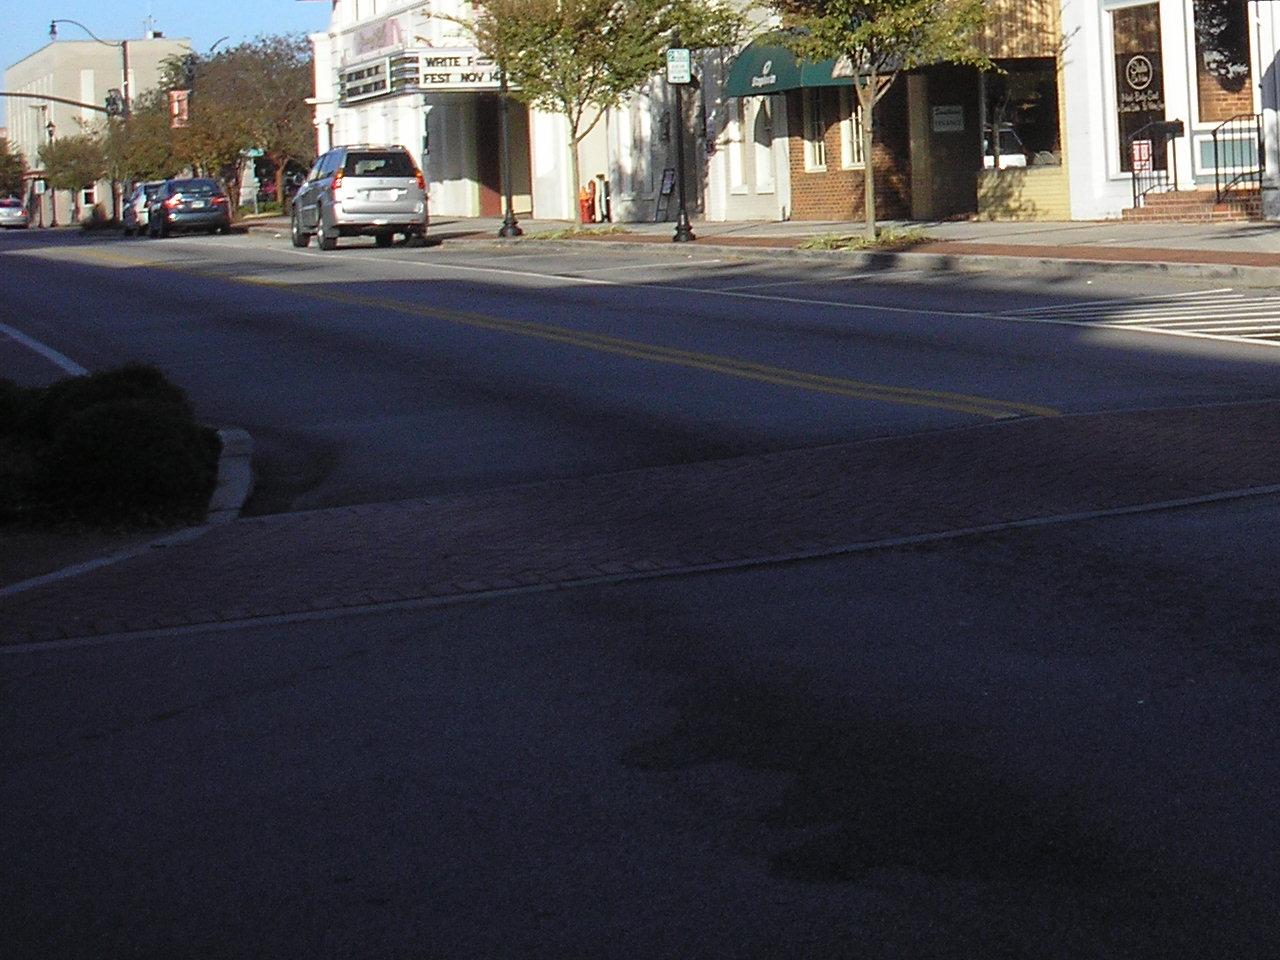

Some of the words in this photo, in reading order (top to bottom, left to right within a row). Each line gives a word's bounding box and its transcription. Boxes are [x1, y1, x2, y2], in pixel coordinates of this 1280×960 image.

[425, 57, 461, 67] WRITE
[424, 73, 451, 83] FEST
[461, 72, 484, 82] NOV
